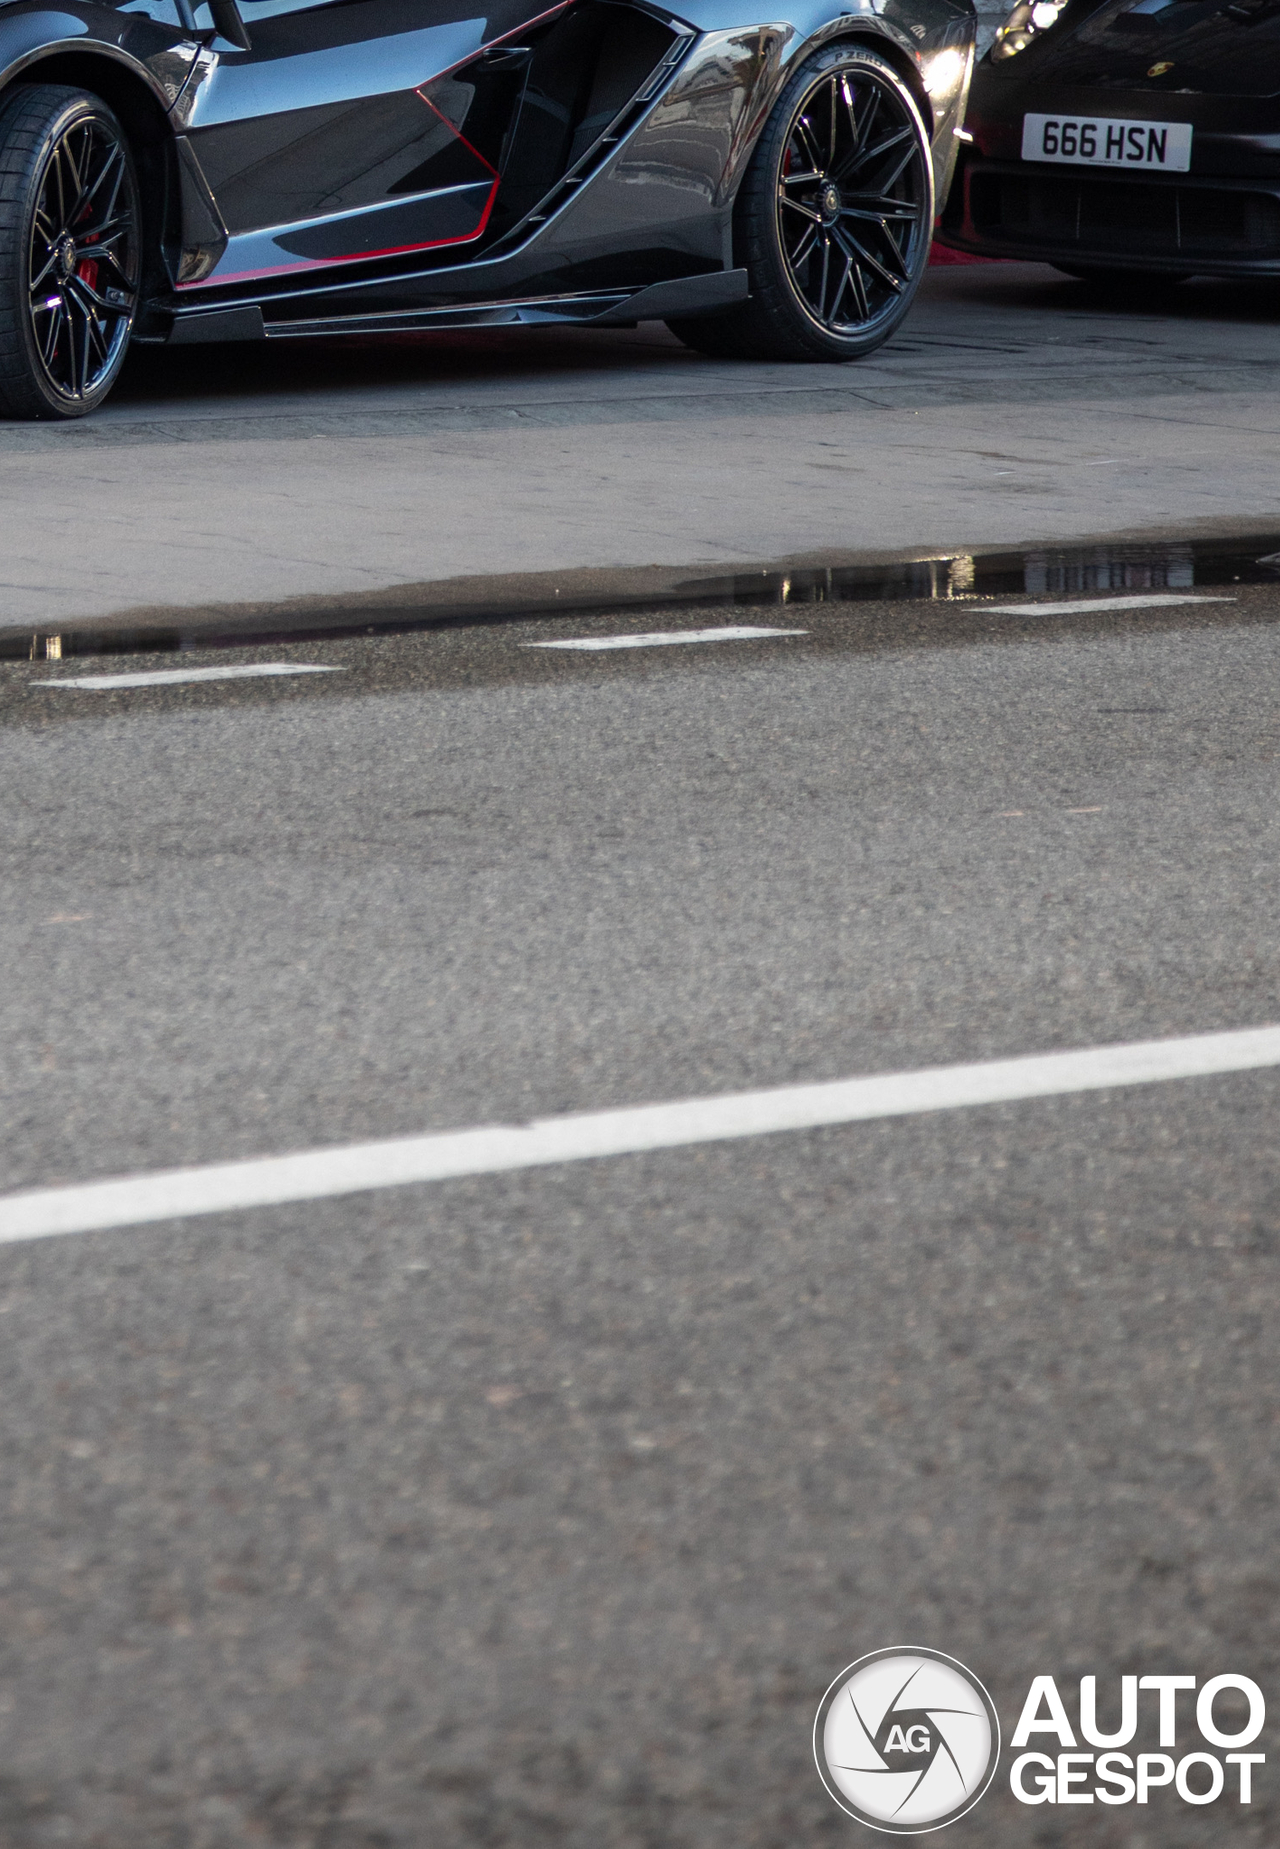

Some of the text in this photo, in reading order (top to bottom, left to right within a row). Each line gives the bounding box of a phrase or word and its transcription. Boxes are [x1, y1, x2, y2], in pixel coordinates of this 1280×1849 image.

[846, 51, 883, 68] ZERO
[1042, 121, 1168, 163] 666 HSN
